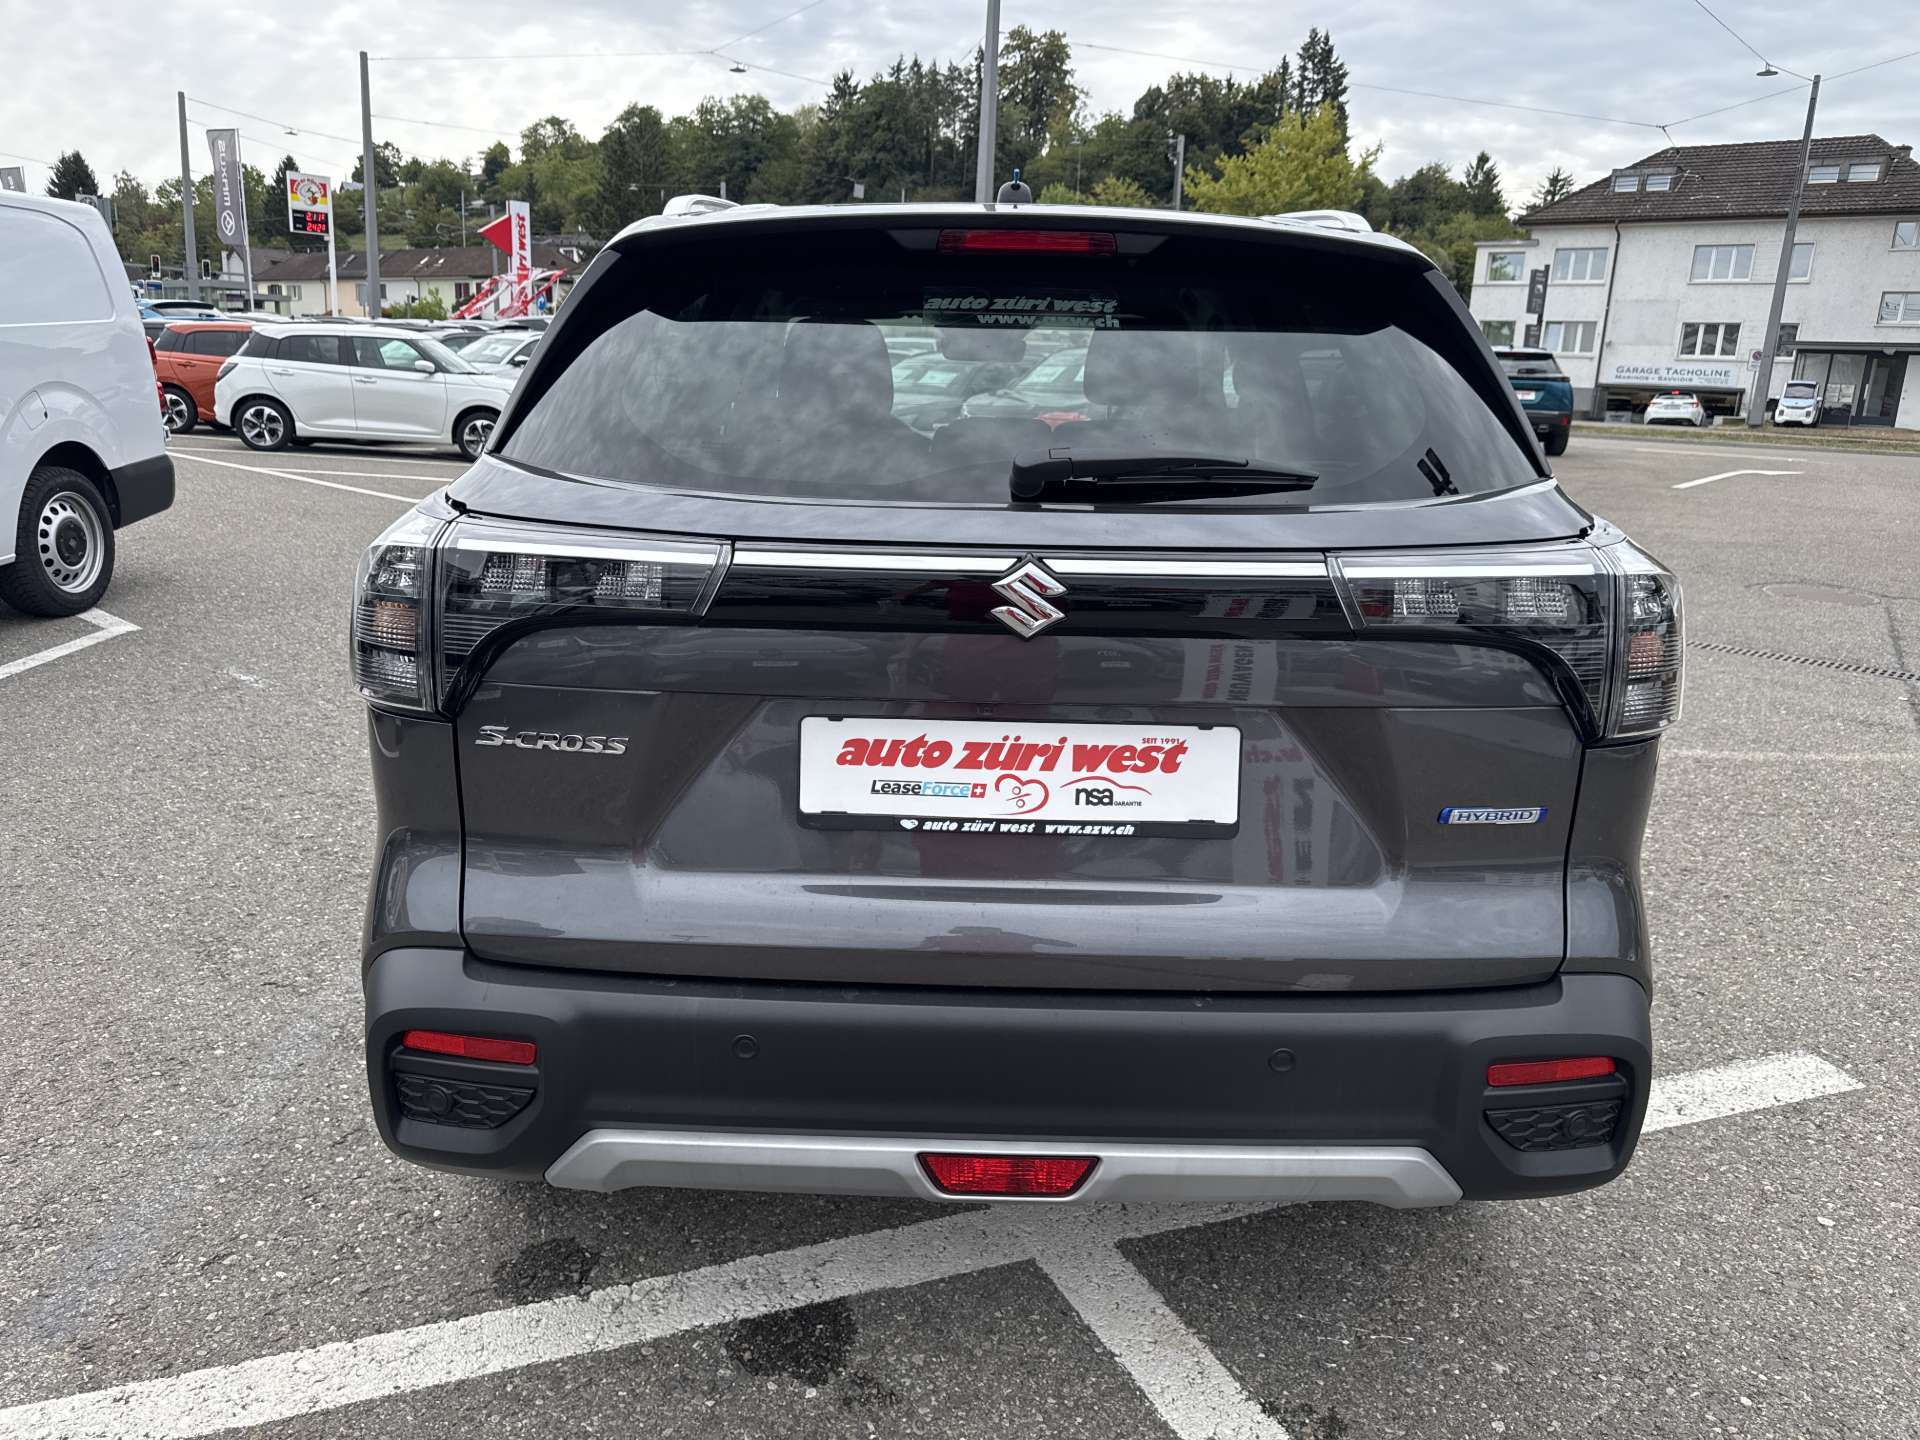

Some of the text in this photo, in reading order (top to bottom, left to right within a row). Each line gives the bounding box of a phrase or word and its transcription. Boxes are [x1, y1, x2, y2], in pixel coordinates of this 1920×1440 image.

[923, 295, 1119, 313] auto züri west
[1616, 365, 1731, 378] GARAGE TACHOLINE
[475, 725, 629, 755] S-CROSS
[1142, 737, 1157, 745] SEIT
[836, 734, 1189, 774] auto züri west
[871, 779, 970, 797] LeaseForce
[1075, 788, 1114, 806] nsa
[1457, 810, 1533, 822] HYBRID
[922, 820, 1135, 836] auto züri west www.azw.ch
